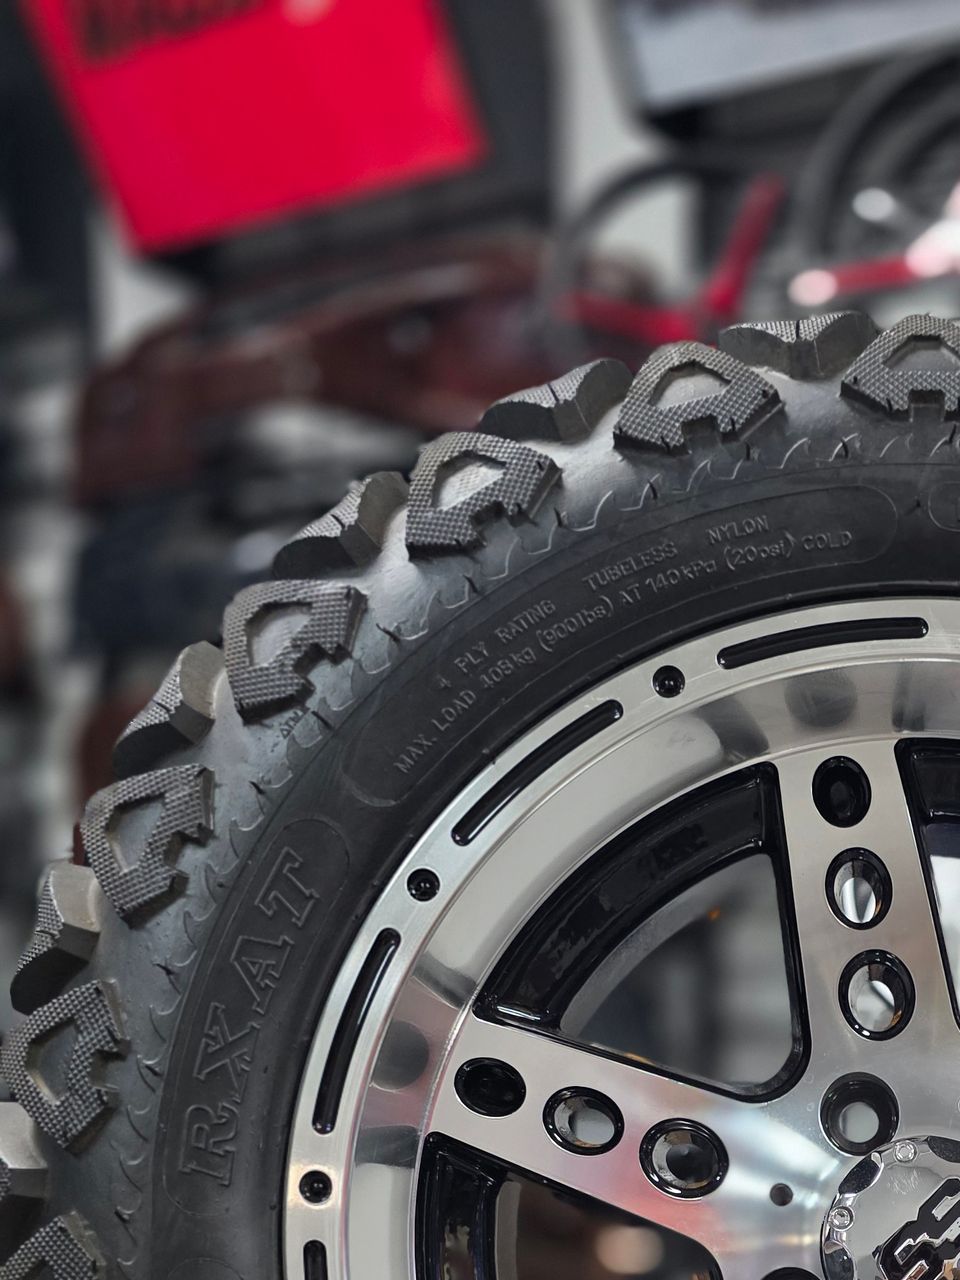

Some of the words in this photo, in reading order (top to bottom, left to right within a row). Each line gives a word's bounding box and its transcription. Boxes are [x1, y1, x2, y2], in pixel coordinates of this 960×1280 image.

[393, 728, 438, 774] MAX.
[431, 687, 479, 732] LOAD
[618, 582, 645, 608] AT
[802, 528, 852, 552] COLD
[454, 640, 491, 675] PLY
[494, 595, 558, 645] RATING
[582, 538, 678, 593] TUBELESS
[707, 512, 769, 544] NYLON
